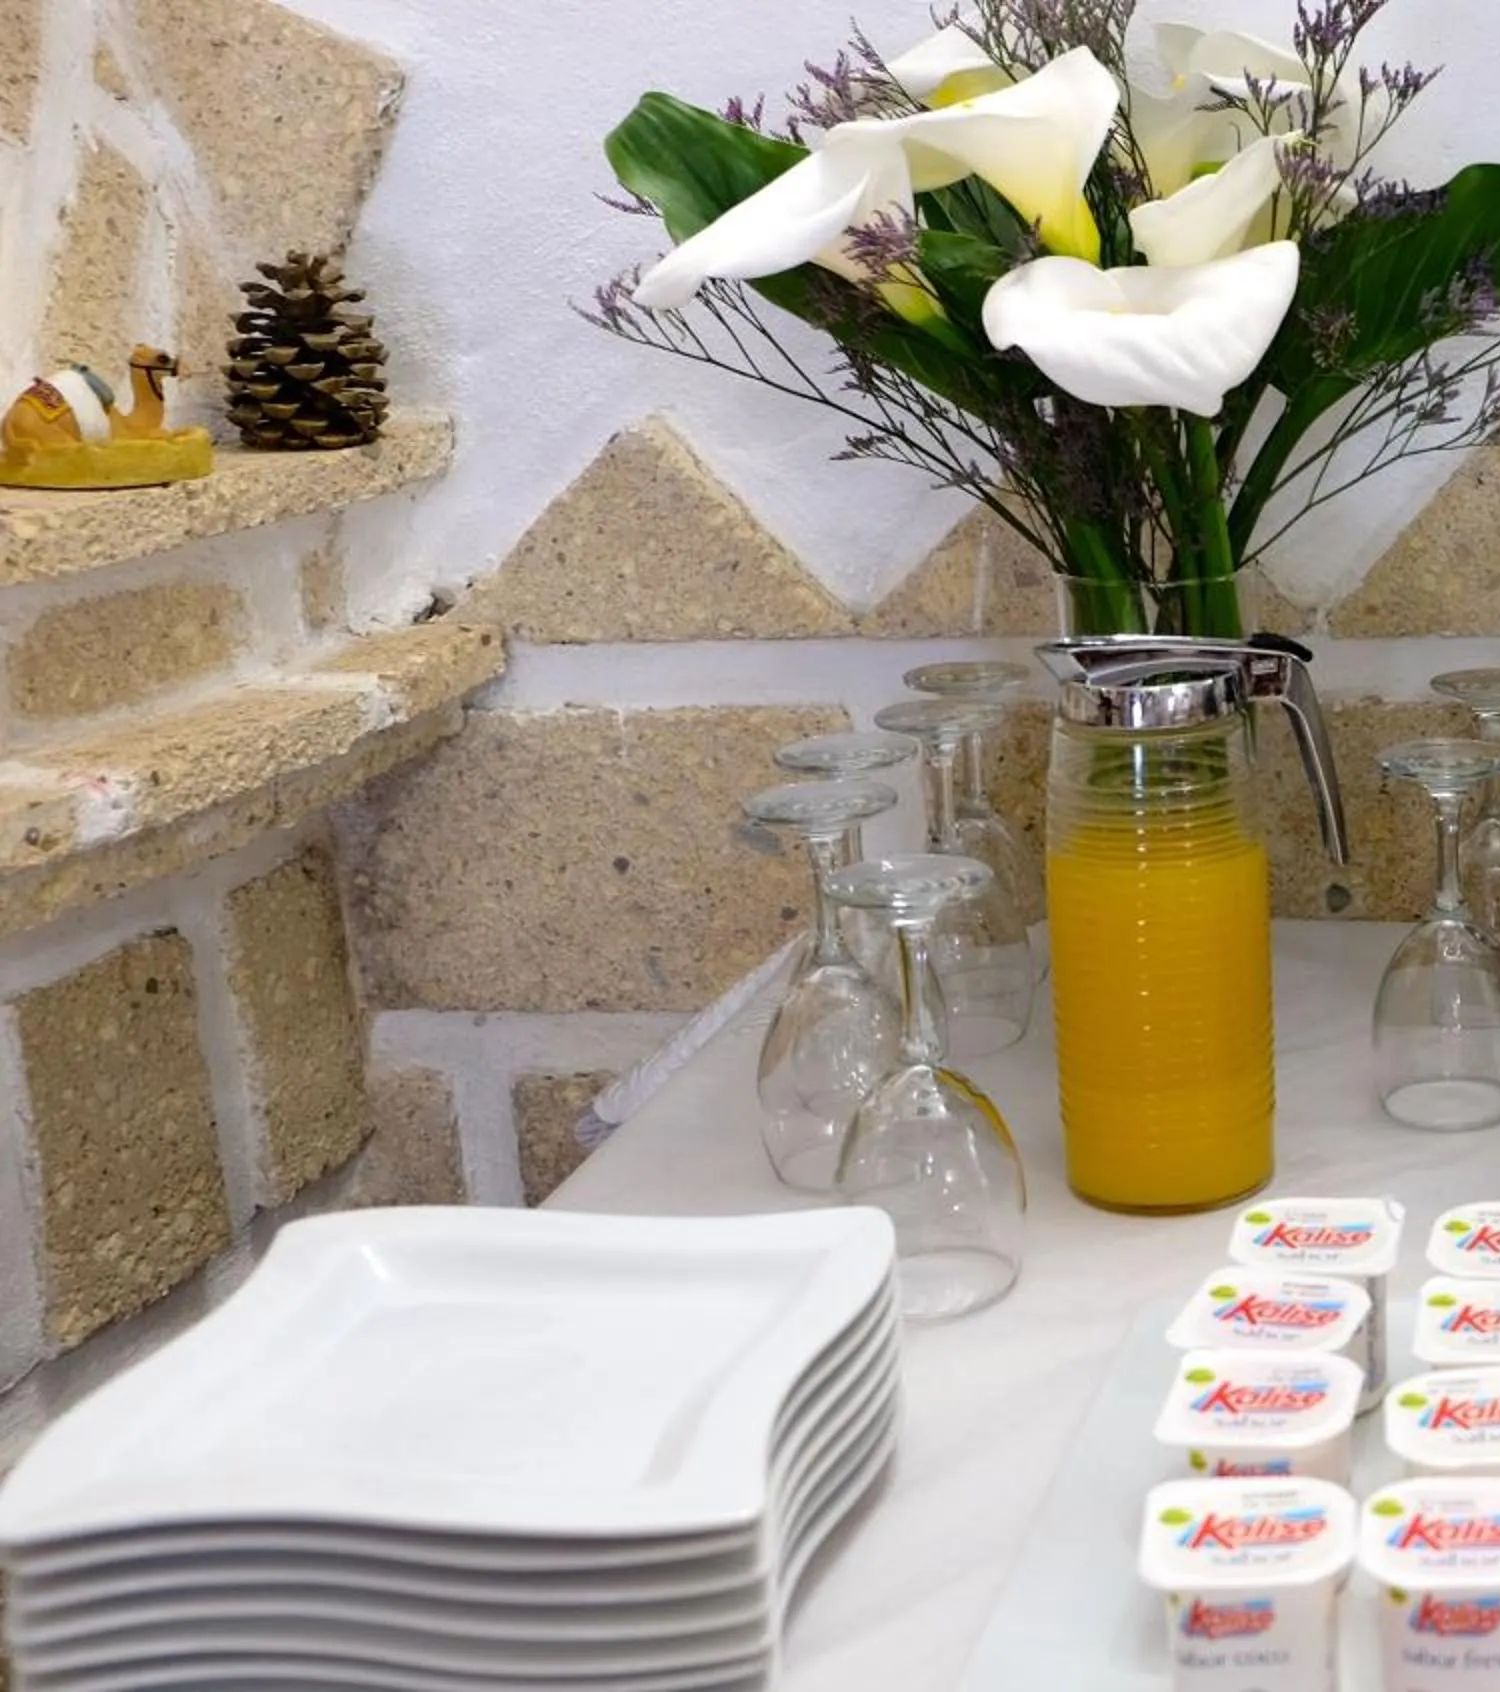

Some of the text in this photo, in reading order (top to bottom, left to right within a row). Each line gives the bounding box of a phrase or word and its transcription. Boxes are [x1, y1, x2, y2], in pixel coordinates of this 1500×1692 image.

[1262, 1221, 1373, 1249] Kalise
[1219, 1294, 1342, 1328] Kalise
[1200, 1380, 1326, 1414] Kalise
[1190, 1513, 1327, 1550] Kalise
